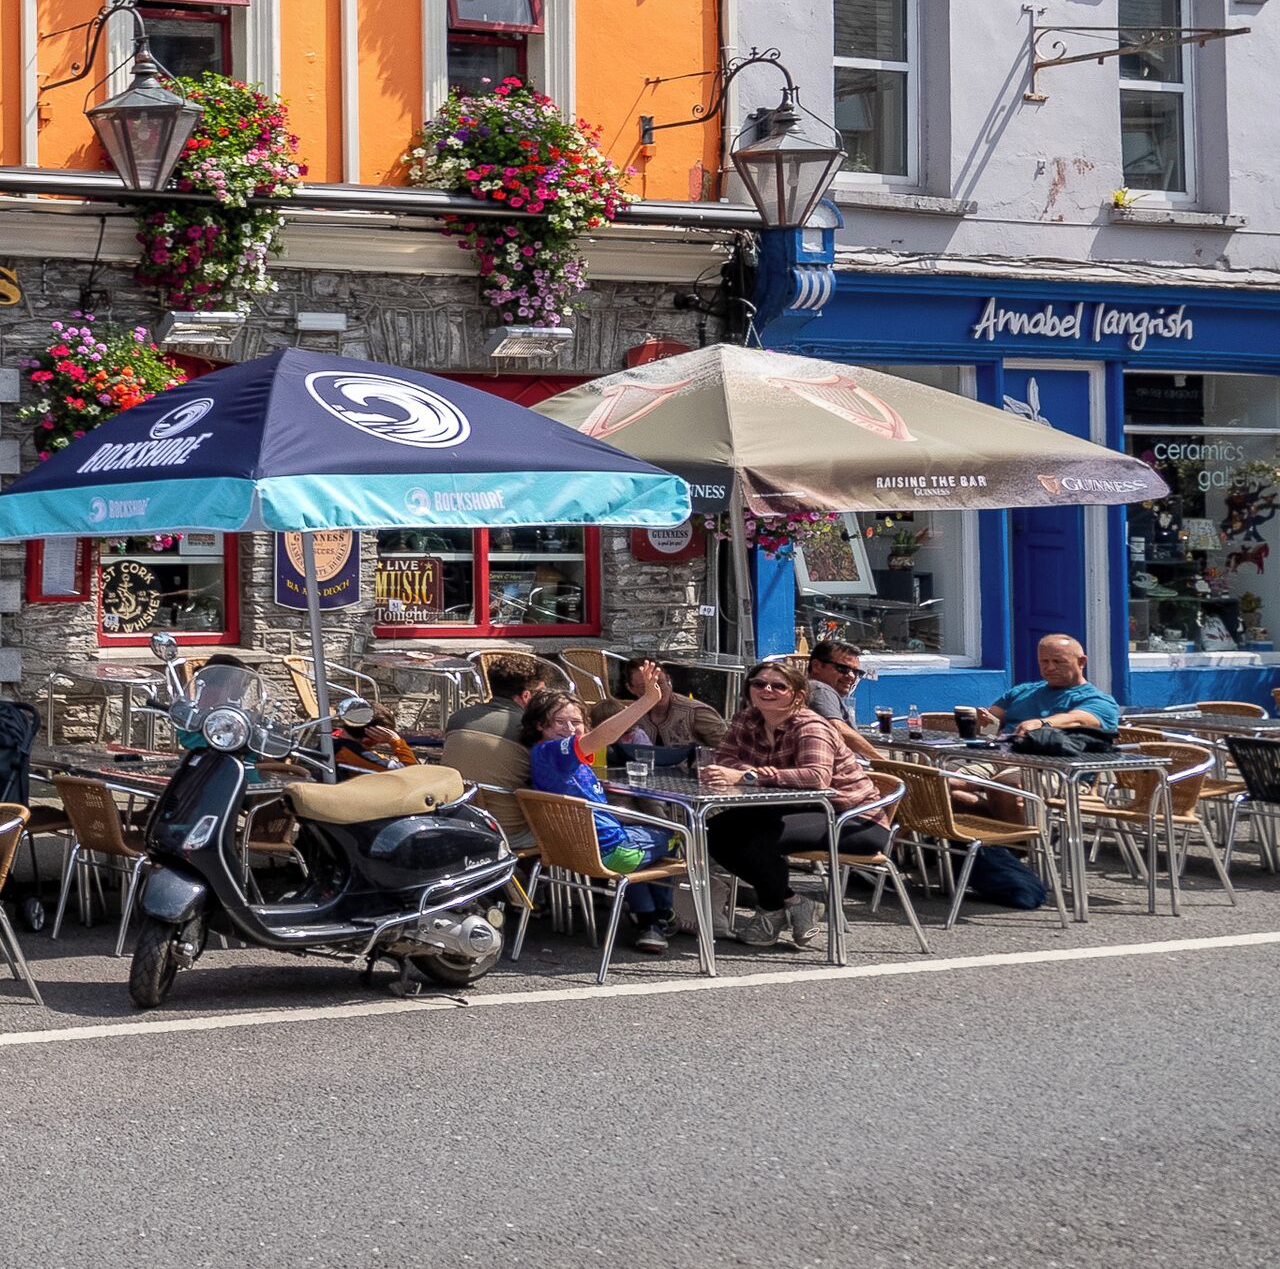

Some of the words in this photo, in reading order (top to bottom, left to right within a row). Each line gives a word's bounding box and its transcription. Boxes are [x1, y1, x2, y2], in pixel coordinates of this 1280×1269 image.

[972, 297, 1084, 341] Annabel
[76, 432, 214, 474] ROCKSHORE
[1154, 443, 1244, 461] ceramics
[876, 476, 927, 489] RAISING
[931, 475, 956, 488] THE
[960, 475, 988, 488] BAR
[1061, 477, 1150, 493] GUINNESS
[433, 490, 506, 511] ROCKSHORE
[293, 533, 345, 542] GNNESS
[121, 562, 156, 585] CORK
[386, 560, 419, 571] LIVE
[122, 590, 161, 634] WHISKEY
